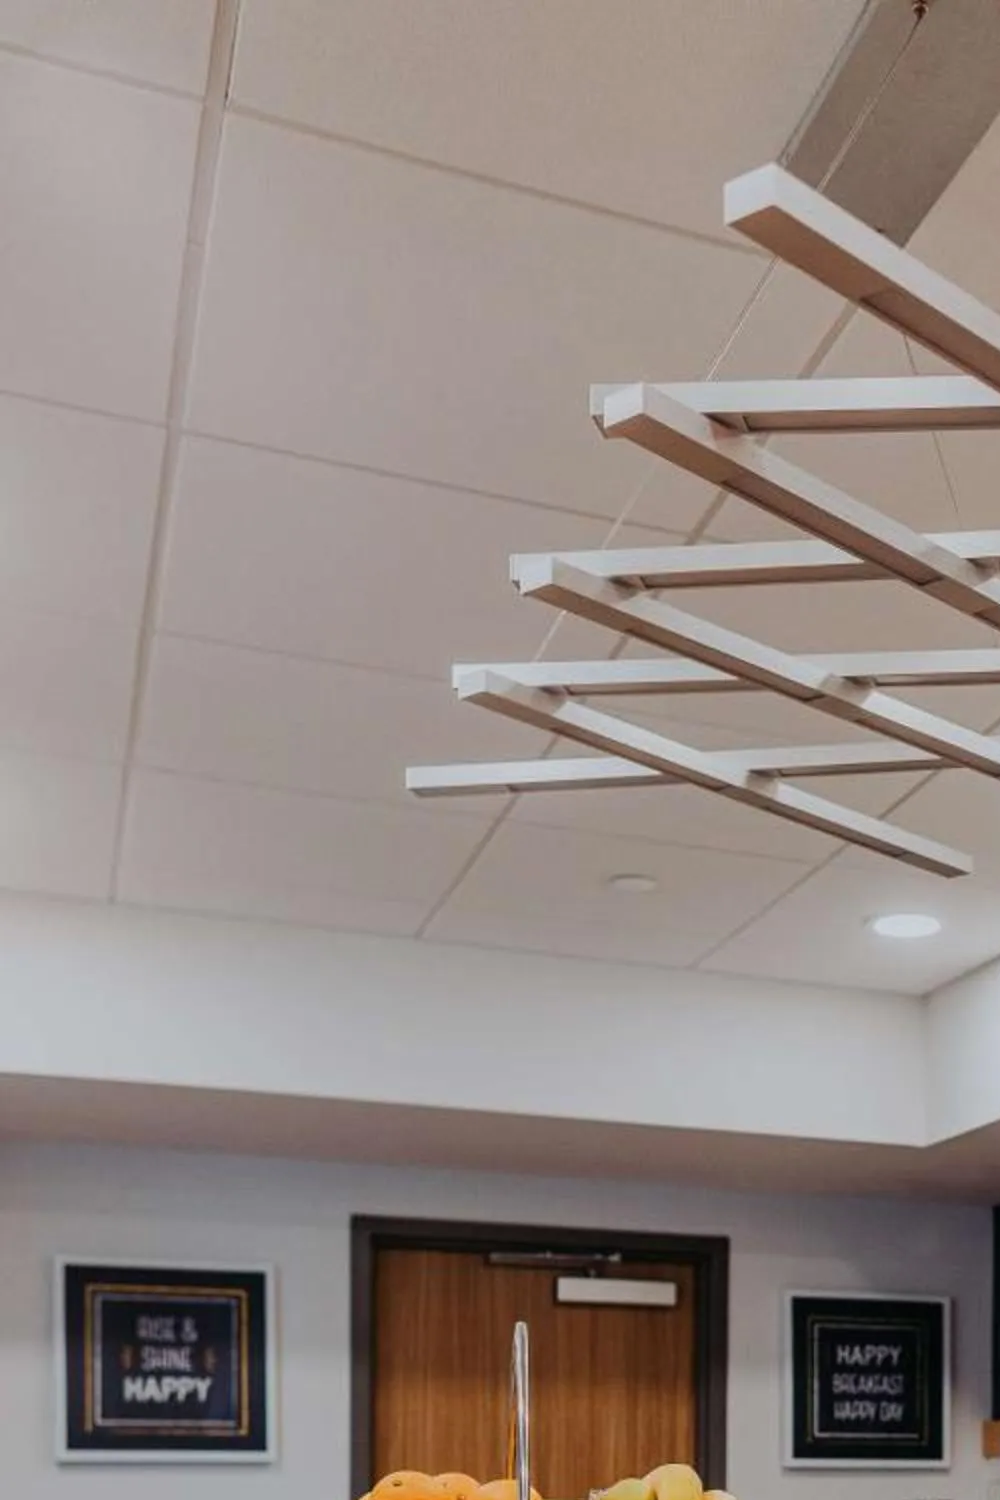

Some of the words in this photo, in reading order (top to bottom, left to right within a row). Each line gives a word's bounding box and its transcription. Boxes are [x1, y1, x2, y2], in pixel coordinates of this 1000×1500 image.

[141, 1346, 191, 1371] SHINE
[836, 1344, 901, 1366] HAPPY
[123, 1376, 212, 1402] HAPPY
[832, 1373, 903, 1394] BREAKFAST
[834, 1401, 876, 1421] HAPPY
[880, 1401, 903, 1421] DAY
